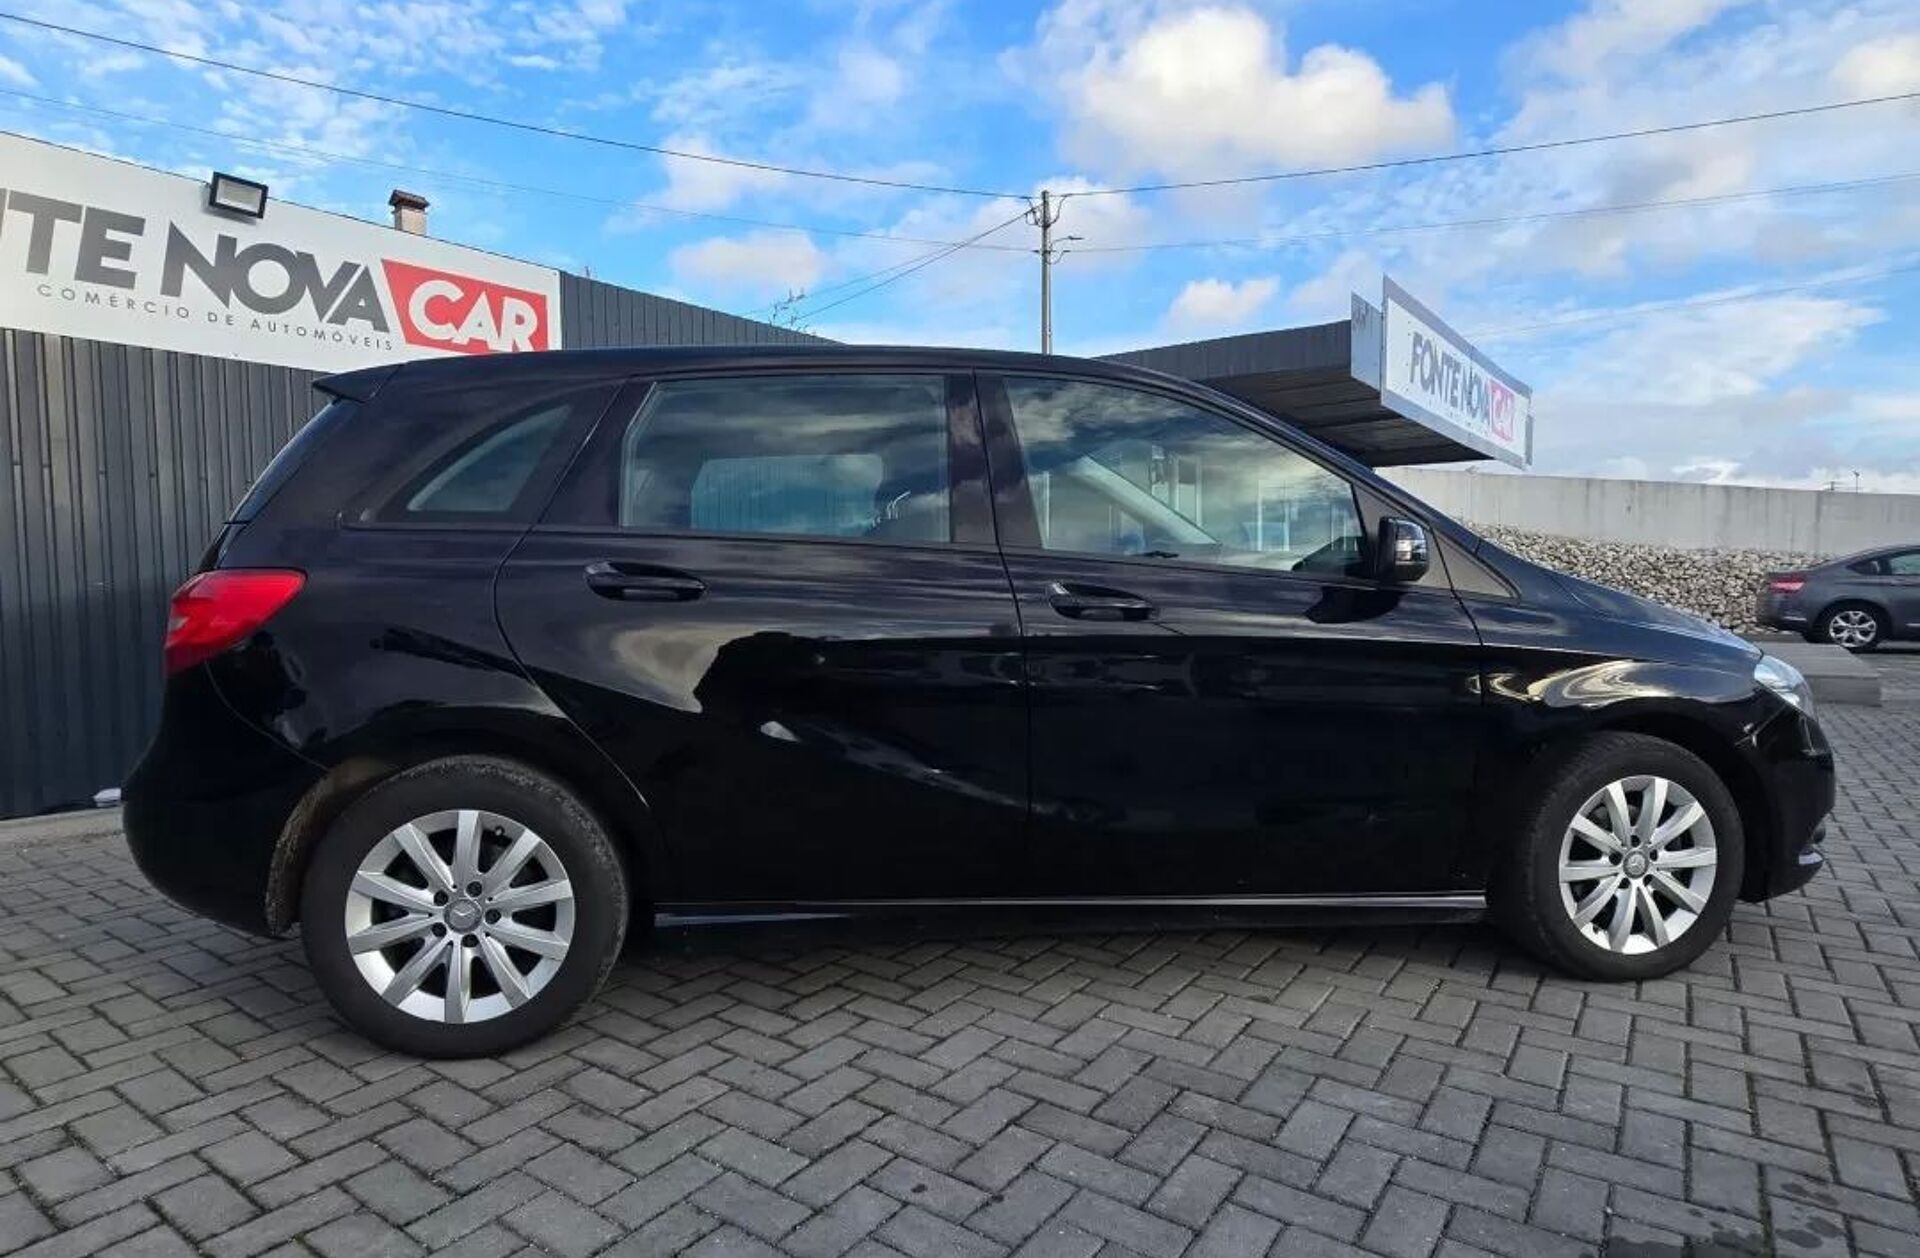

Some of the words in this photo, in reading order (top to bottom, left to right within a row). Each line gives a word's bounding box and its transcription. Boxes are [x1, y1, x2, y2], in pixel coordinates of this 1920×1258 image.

[0, 187, 146, 290] TE
[160, 220, 390, 333] NOVA
[408, 279, 538, 352] CAR
[36, 283, 190, 319] COMÉRCIO
[207, 311, 235, 326] DE
[250, 318, 393, 351] AUTOMÓVEIS
[1409, 331, 1461, 409] FONTE
